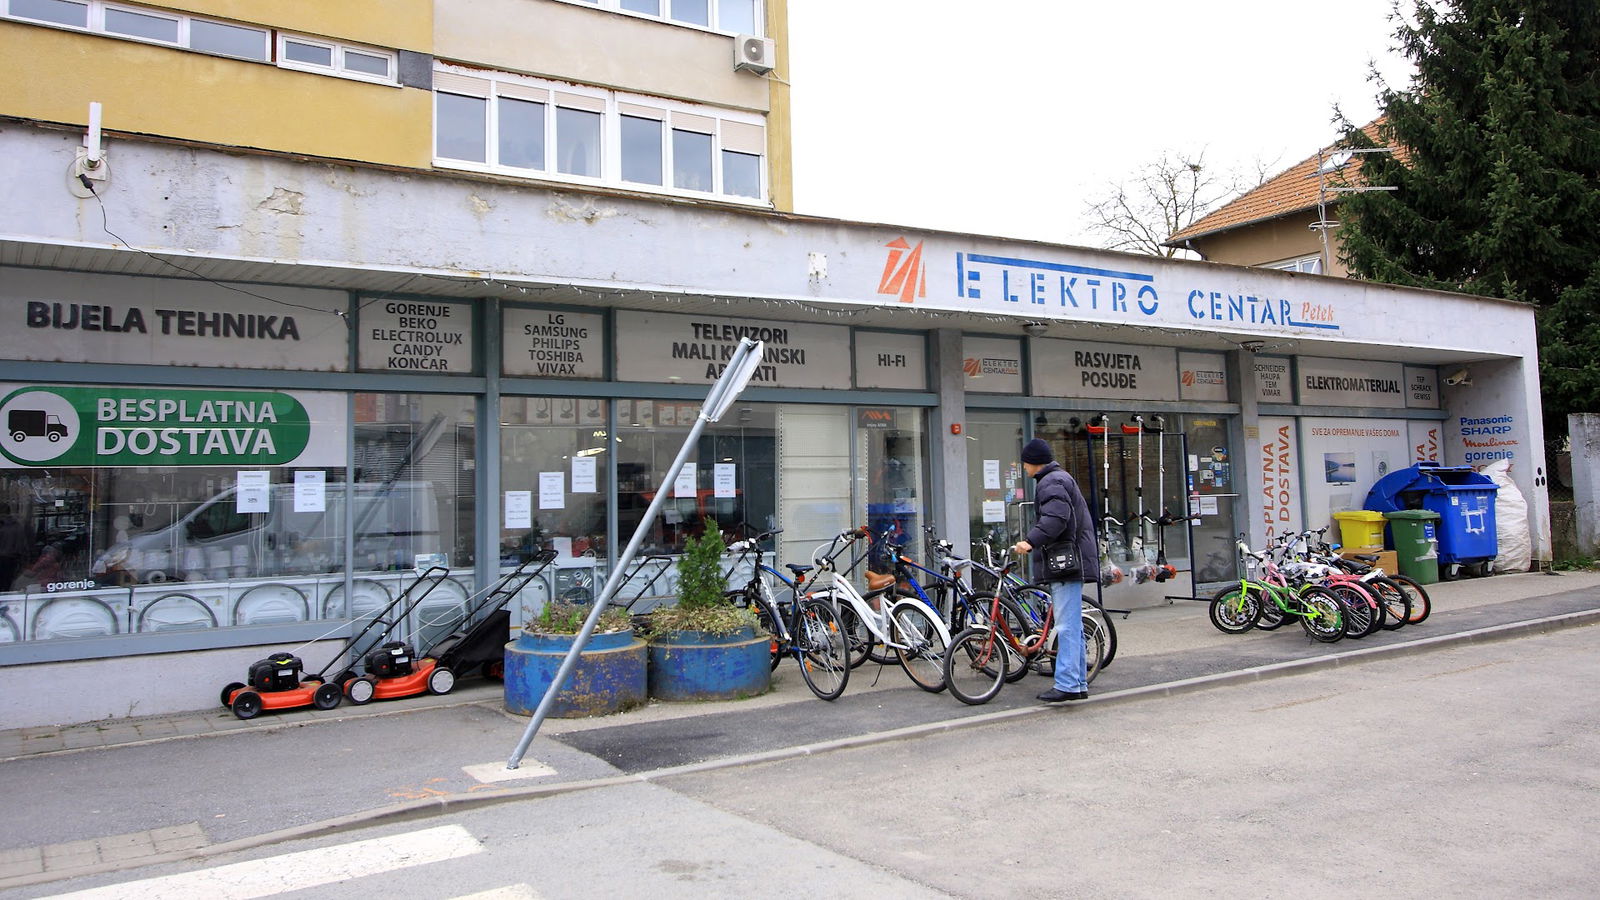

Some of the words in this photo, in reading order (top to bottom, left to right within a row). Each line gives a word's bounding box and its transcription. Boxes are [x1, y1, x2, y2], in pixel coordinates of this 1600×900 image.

[956, 252, 1159, 316] ELEKTRO
[1187, 289, 1292, 326] CENTAR
[1302, 301, 1334, 321] Petek
[385, 302, 450, 318] GORENJE
[26, 301, 147, 334] BIJELA
[155, 309, 300, 340] TEHNIKA
[400, 317, 437, 330] BEKO
[548, 314, 565, 325] LG
[372, 329, 463, 345] ELECTROLUX
[524, 325, 588, 339] SAMSUNG
[691, 322, 788, 345] TELEVIZORI
[393, 344, 443, 357] CANDY
[532, 338, 580, 351] PHILIPS
[528, 350, 584, 363] TOSHIBA
[672, 342, 716, 360] MALI
[721, 344, 806, 365] KNSKI
[878, 354, 906, 368] HI-FI
[1074, 350, 1141, 370] RASVJETA
[388, 355, 448, 370] KONČAR
[537, 362, 576, 375] VIVAX
[1254, 364, 1286, 373] SCHNEIDER
[705, 363, 777, 382] APATI
[1081, 371, 1137, 389] POSUĐE
[1306, 375, 1401, 394] ELEKTROMATERIJAL
[97, 398, 278, 424] BESPLATNA
[1460, 414, 1513, 426] Panasonic
[1461, 426, 1512, 436] SHARP
[97, 427, 277, 456] DOSTAVA
[1462, 437, 1520, 448] Moulinex
[1279, 425, 1290, 522] DOSTAVA
[1263, 442, 1275, 549] ESPLATNA
[46, 579, 95, 592] gorenje
